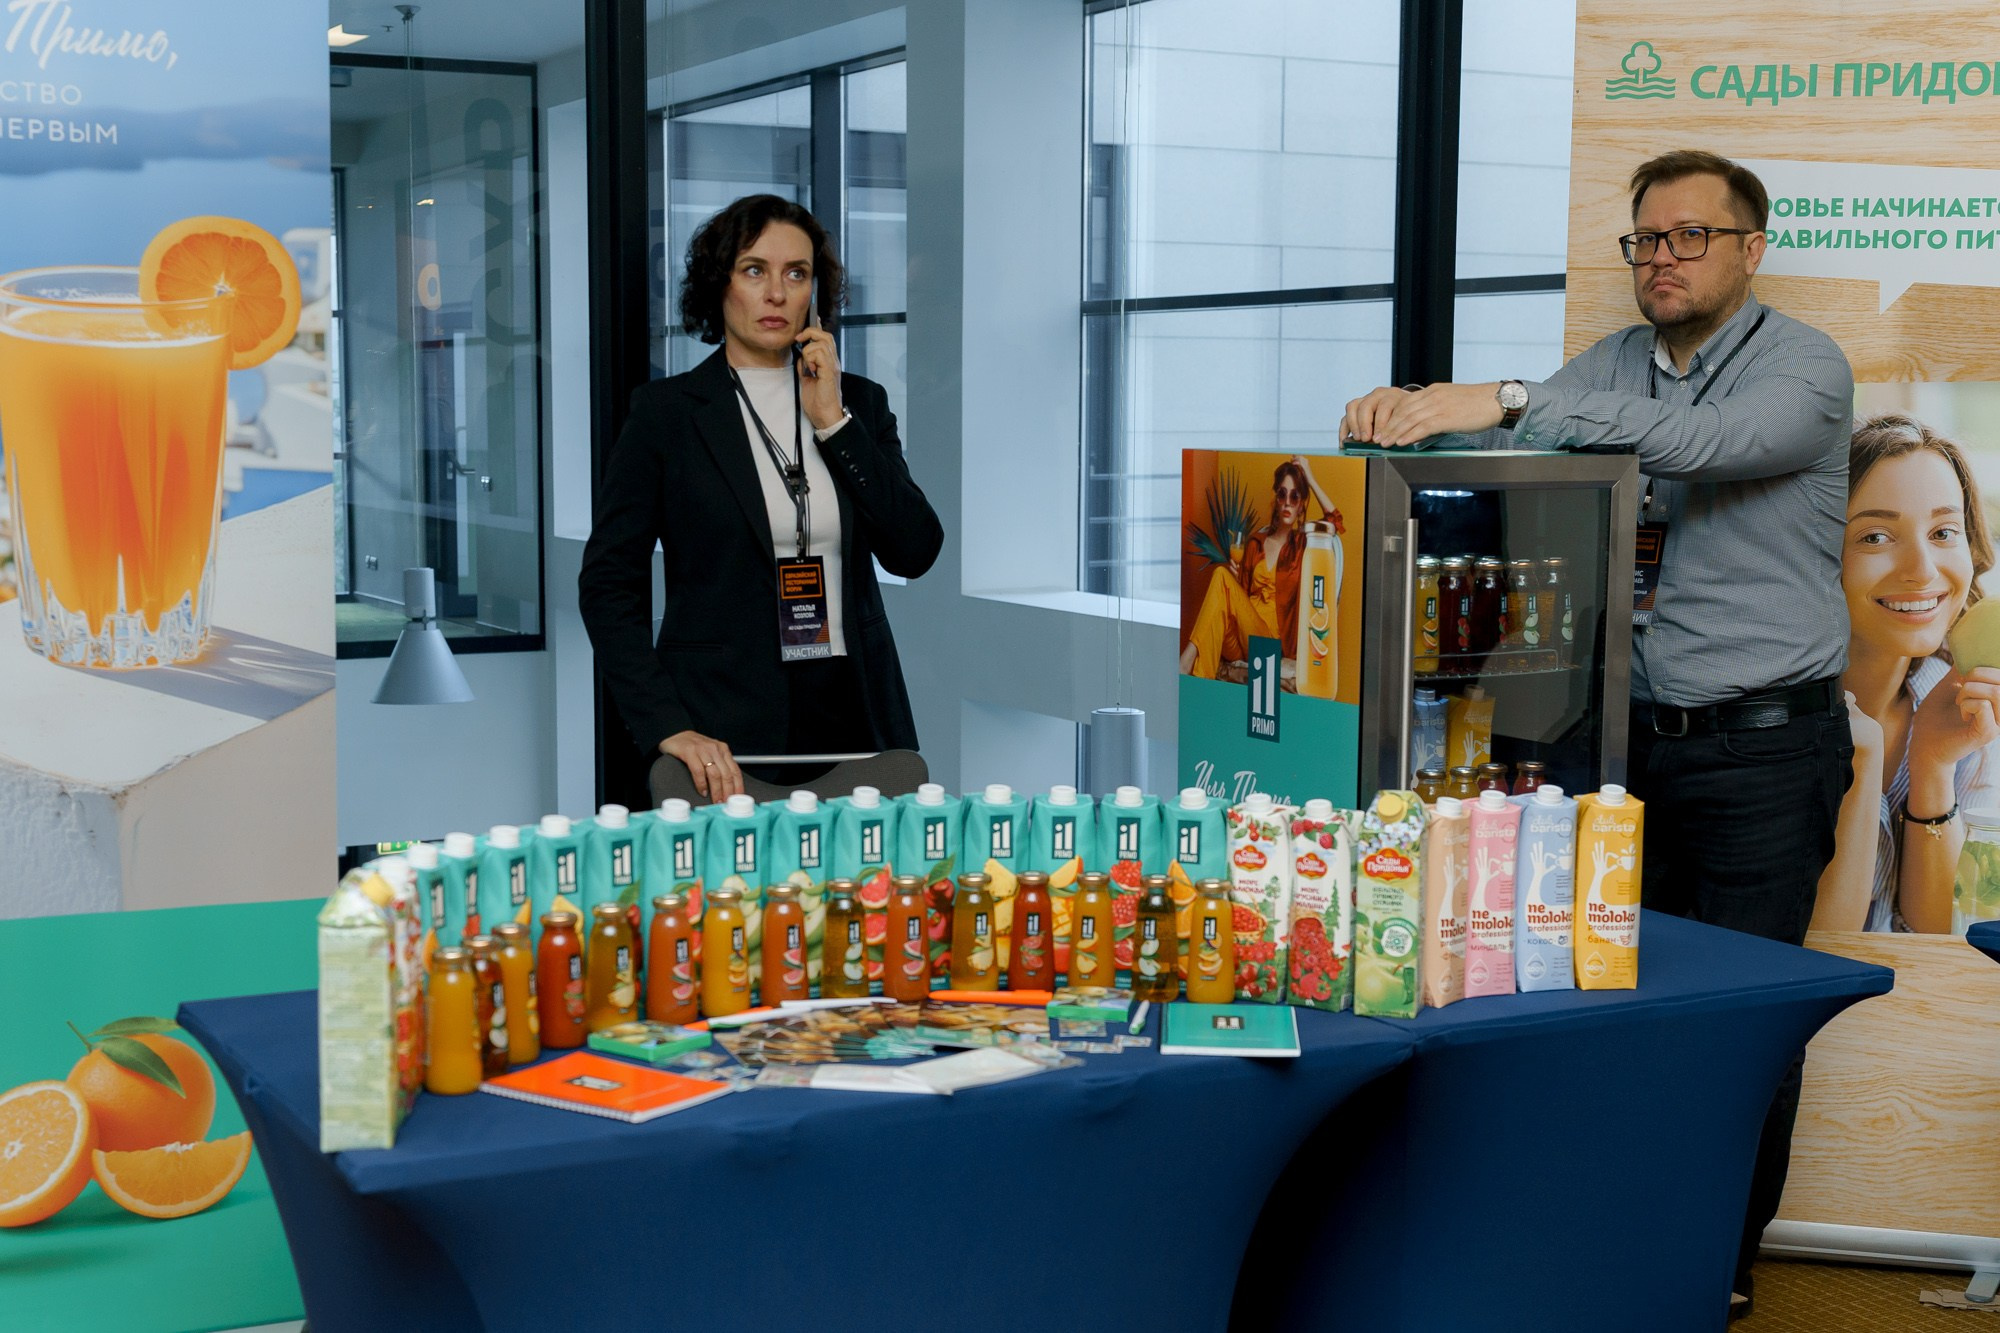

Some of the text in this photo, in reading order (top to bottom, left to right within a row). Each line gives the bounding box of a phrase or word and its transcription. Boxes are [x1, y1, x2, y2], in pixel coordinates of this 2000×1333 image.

[1691, 63, 1818, 106] САДЫ
[0, 118, 117, 145] ЕРВЫМ
[1852, 197, 2000, 218] НАЧИНАЕТ
[792, 604, 816, 612] НАТАЛЬЯ
[785, 646, 829, 659] УЧАСТНИК
[1253, 654, 1275, 717] il
[1252, 717, 1275, 737] PRIMO
[927, 822, 944, 850] il
[993, 821, 1010, 849] il
[1055, 822, 1073, 850] il
[1120, 823, 1138, 850] il
[1530, 822, 1572, 833] barista
[1592, 822, 1636, 833] barista
[863, 825, 881, 853] il
[1181, 827, 1199, 854] il
[1367, 861, 1411, 874] Придонья
[1376, 855, 1400, 867] Сады
[1472, 910, 1489, 919] ne
[1528, 903, 1545, 913] ne
[1588, 902, 1605, 913] ne
[1588, 910, 1635, 923] moloko
